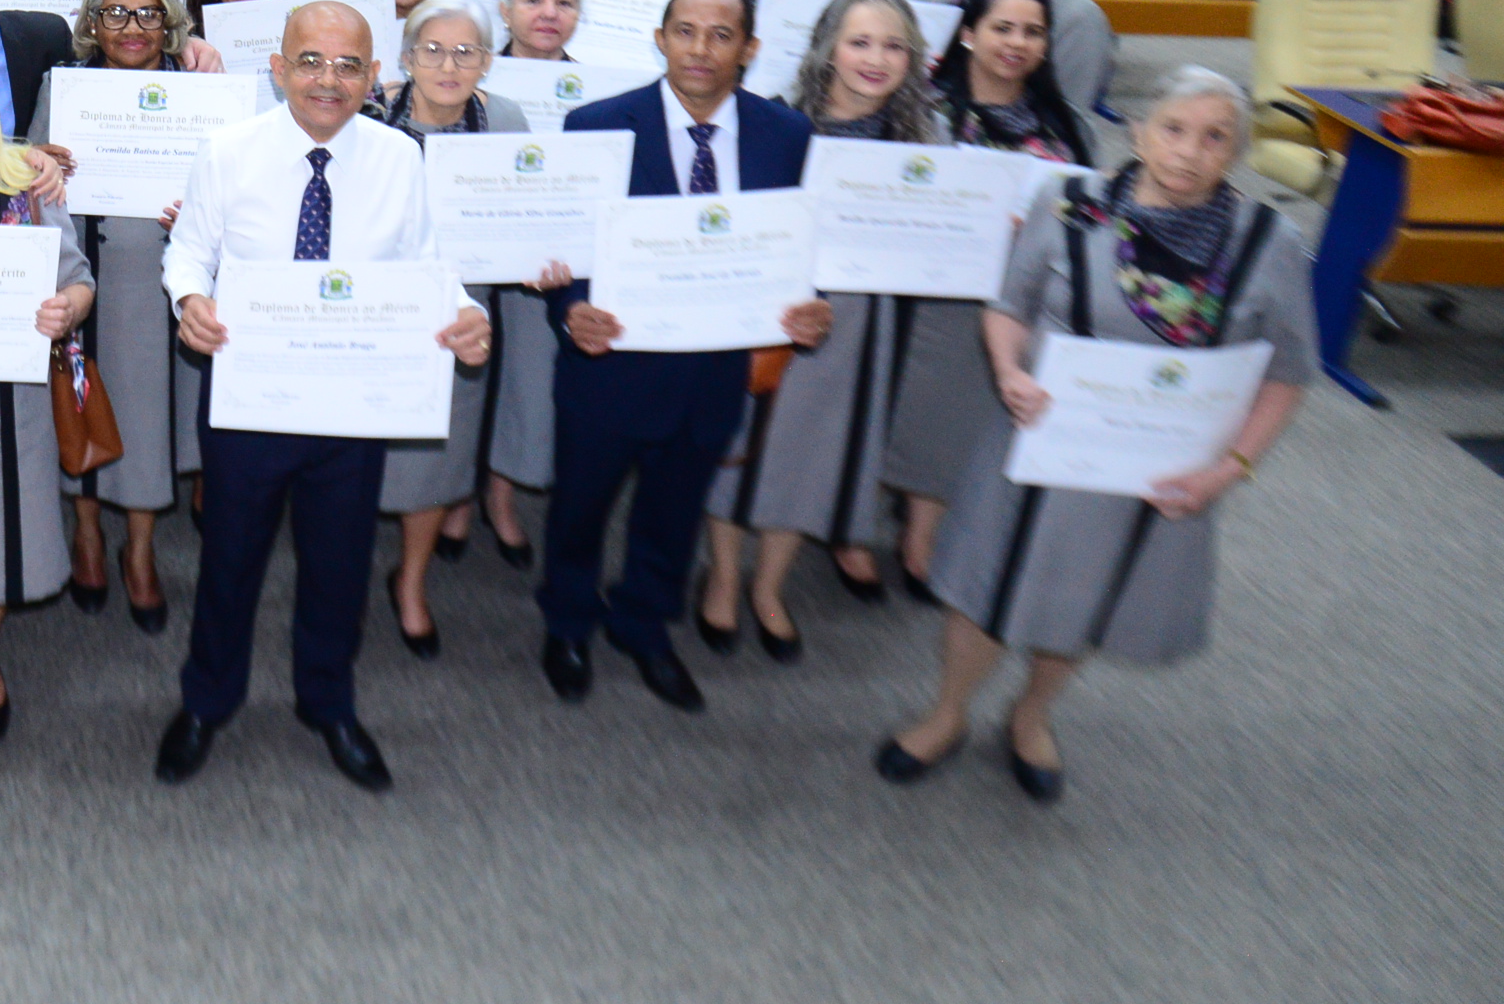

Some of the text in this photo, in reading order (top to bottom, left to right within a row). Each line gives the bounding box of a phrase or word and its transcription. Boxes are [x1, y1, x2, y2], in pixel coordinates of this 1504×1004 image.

[234, 37, 274, 48] Diploma
[80, 110, 225, 125] Diploma de Honra ao Mérito
[95, 146, 131, 155] Cremilda
[133, 147, 160, 156] Batista
[161, 148, 171, 156] de
[249, 301, 420, 315] Diploma de Honra ao Mérito
